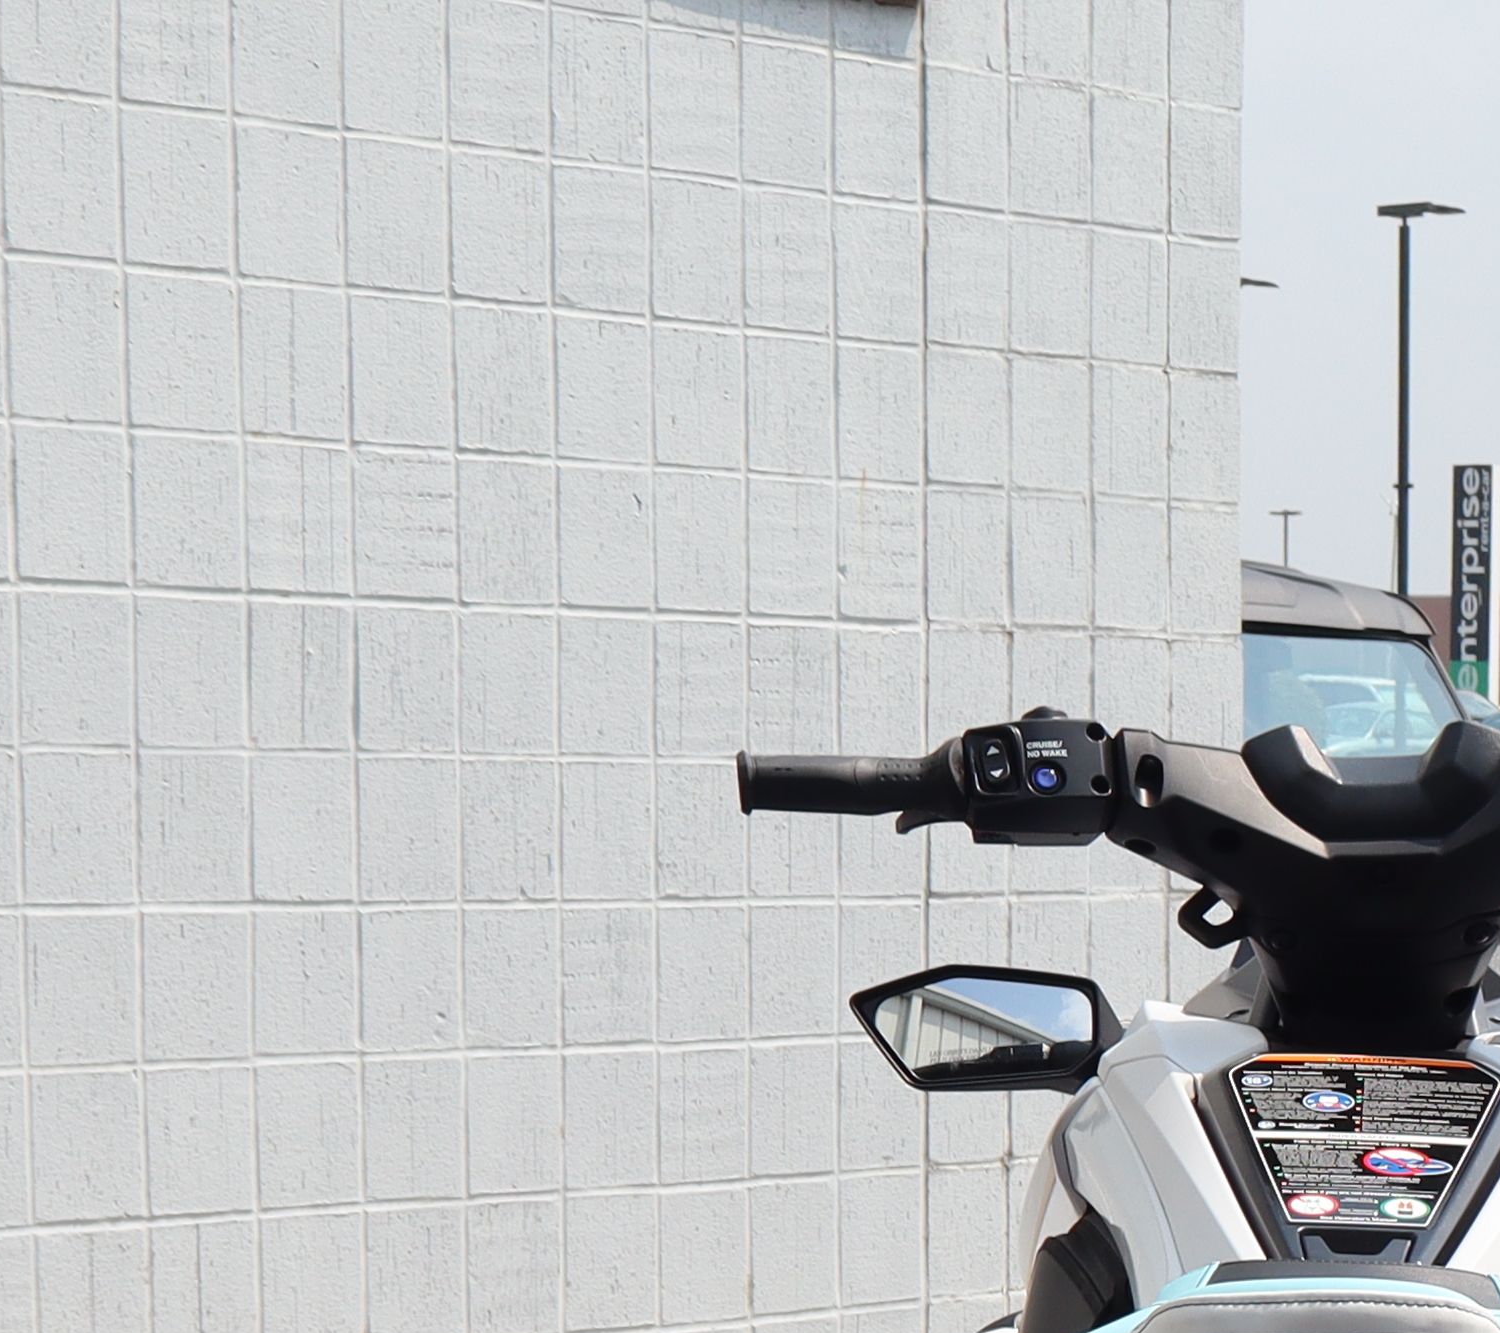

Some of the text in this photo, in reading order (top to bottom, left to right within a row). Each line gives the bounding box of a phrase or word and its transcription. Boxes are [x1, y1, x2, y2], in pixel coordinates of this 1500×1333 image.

[1479, 469, 1490, 552] rent-a-car
[1457, 467, 1485, 692] enterprise
[1026, 740, 1063, 749] CRUISE/
[1027, 749, 1068, 759] NO WAKE
